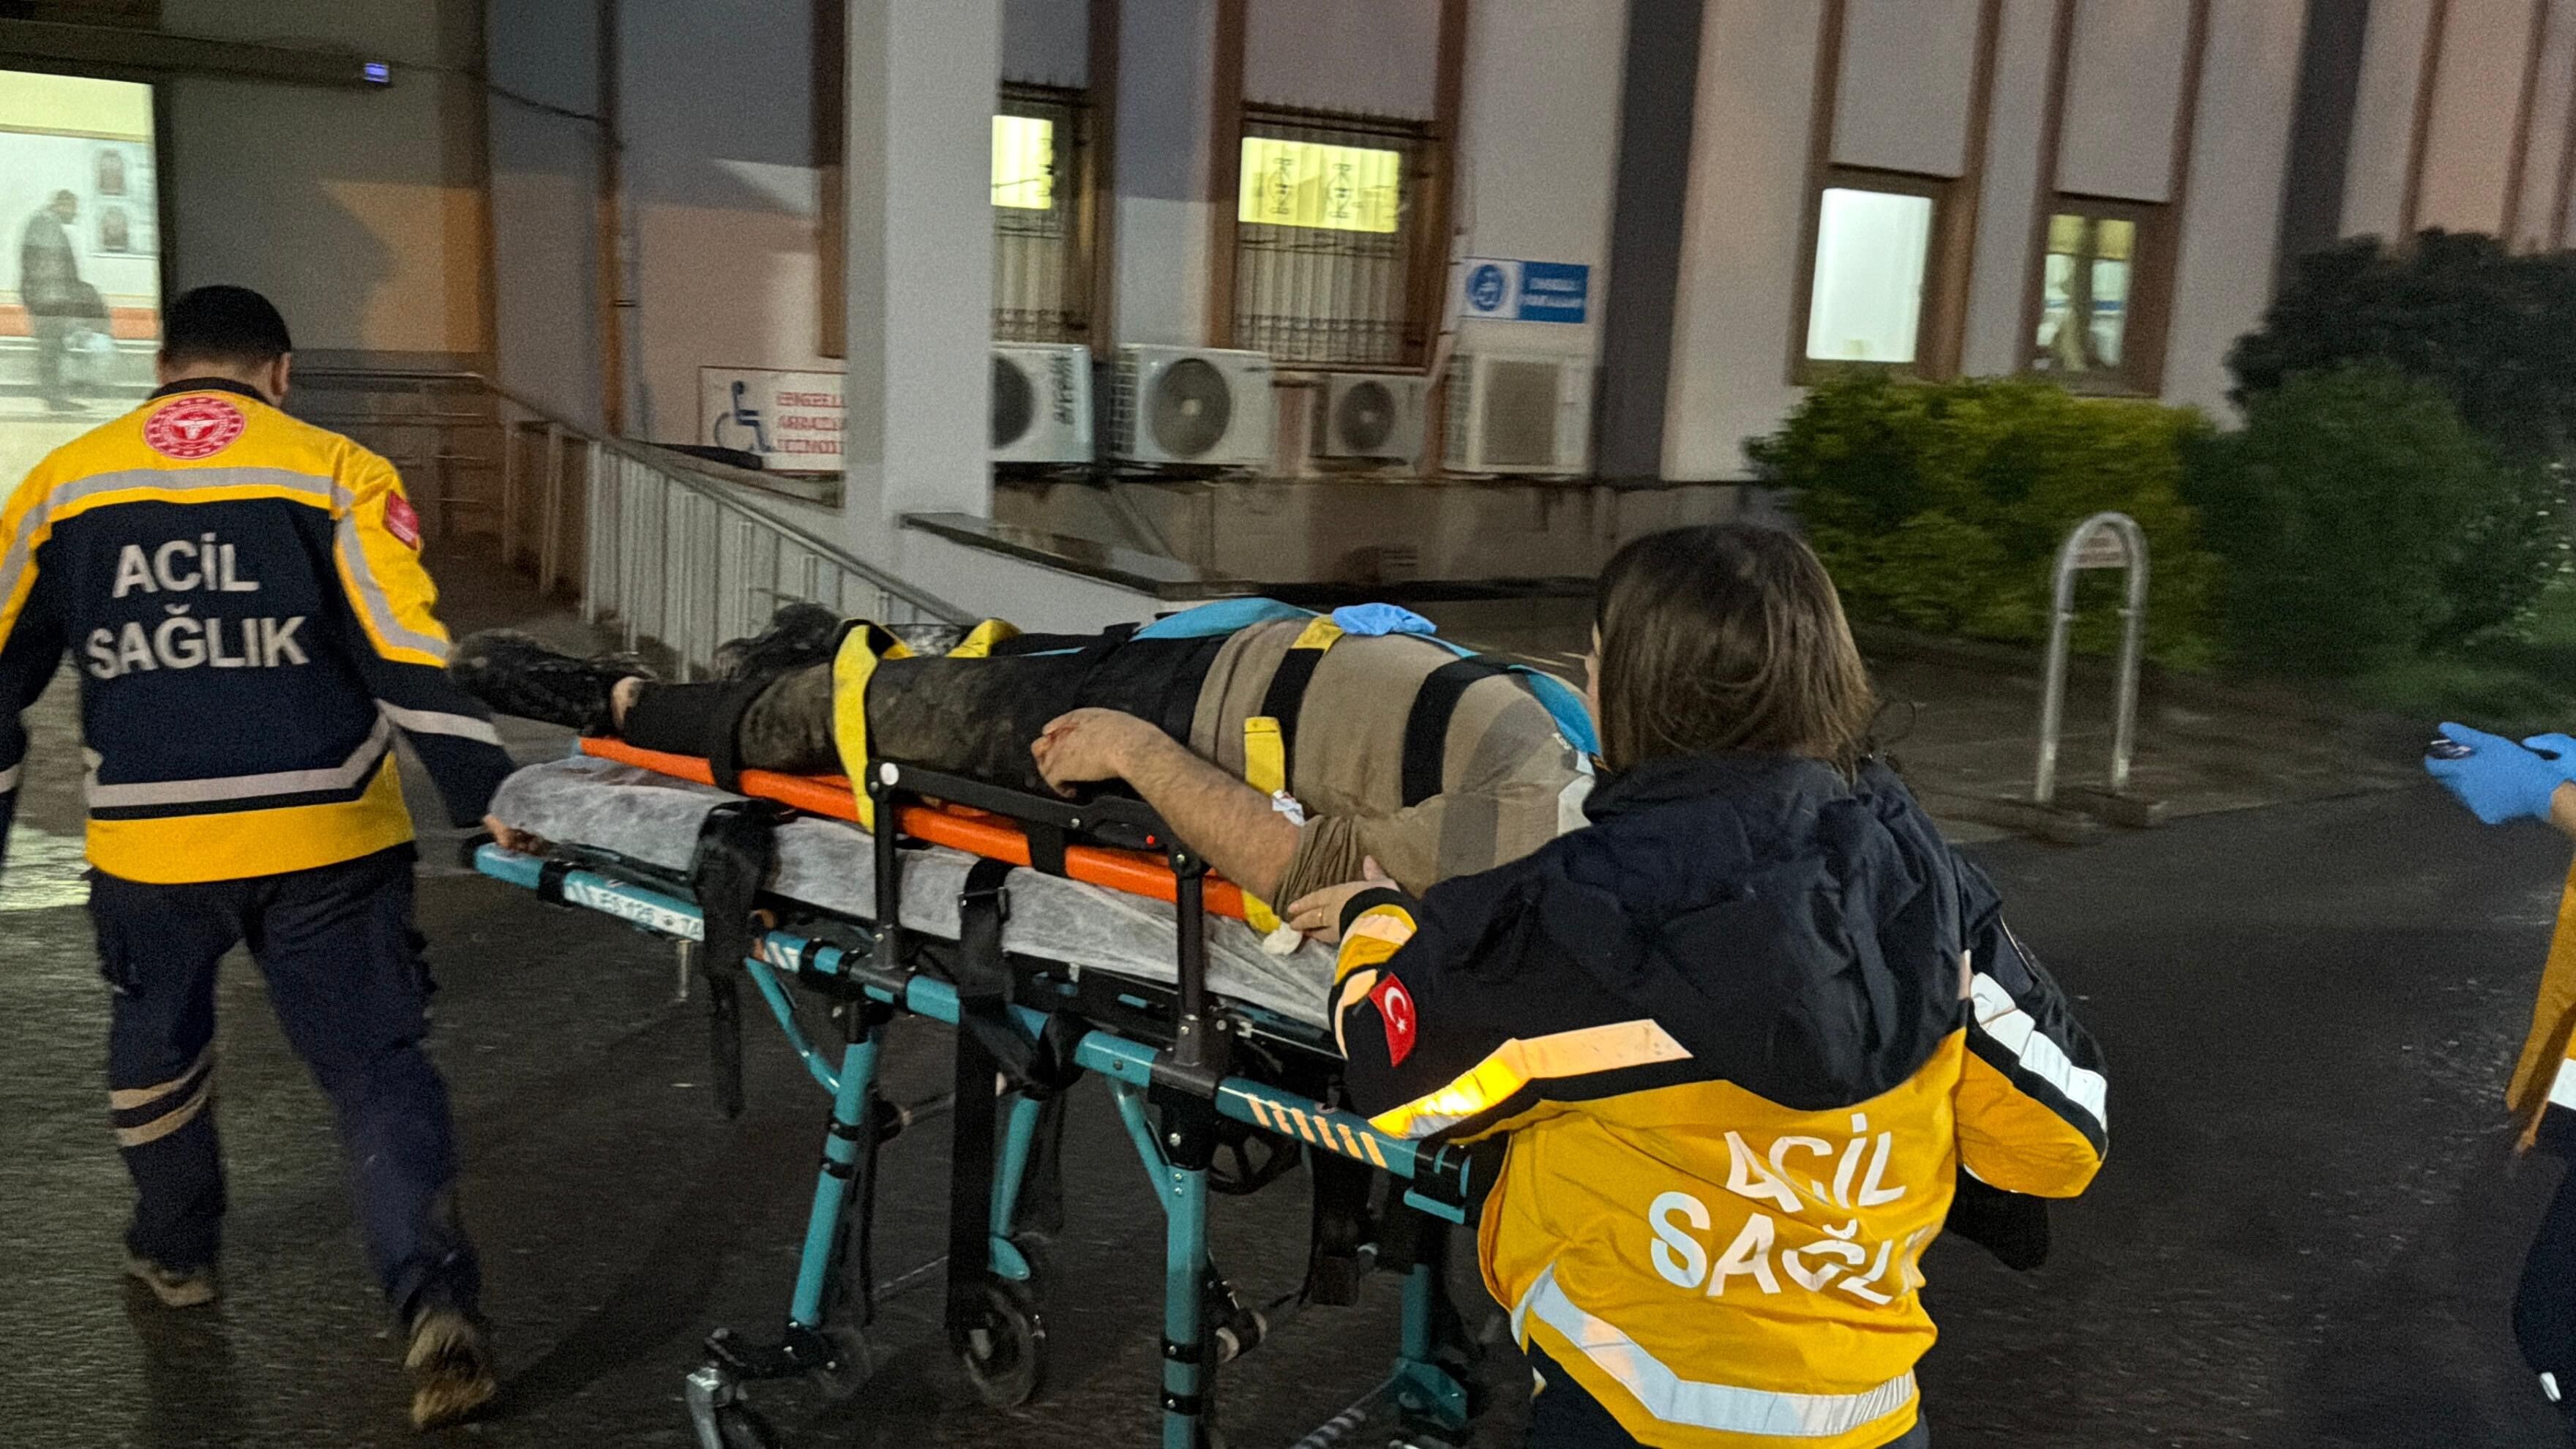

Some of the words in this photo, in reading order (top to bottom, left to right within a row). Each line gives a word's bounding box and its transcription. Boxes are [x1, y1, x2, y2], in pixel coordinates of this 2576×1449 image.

[112, 532, 260, 598] ACİL
[85, 604, 310, 679] SAĞLIK
[1724, 1112, 1907, 1213] ACİL
[1648, 1191, 1926, 1306] SAĞL
